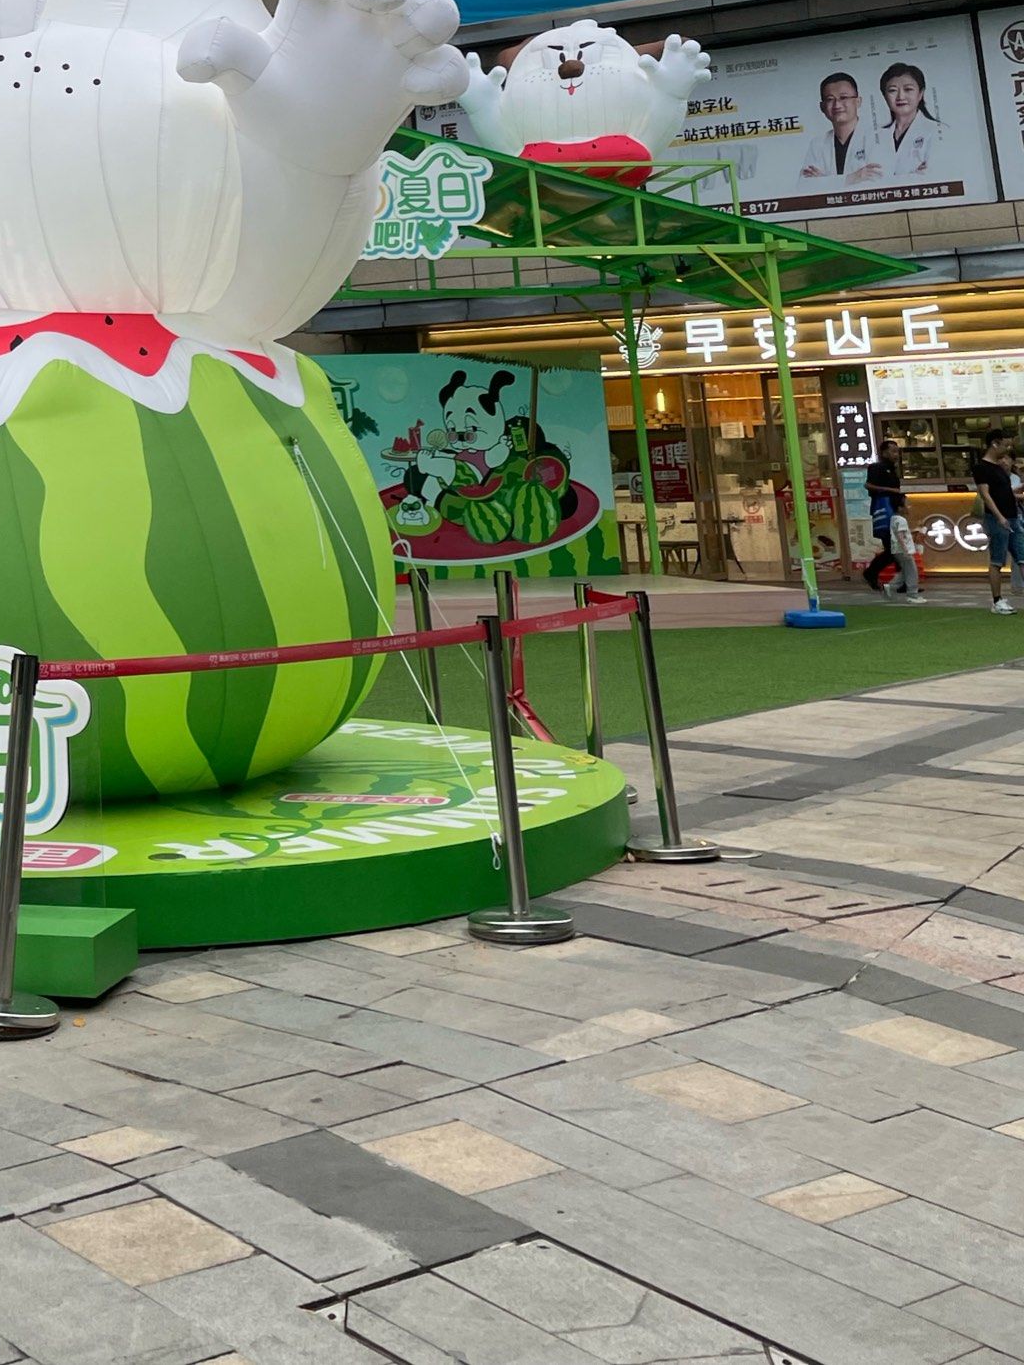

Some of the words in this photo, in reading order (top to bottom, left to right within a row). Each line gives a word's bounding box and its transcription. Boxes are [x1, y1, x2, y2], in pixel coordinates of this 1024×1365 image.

[379, 153, 483, 215] 夏日
[749, 202, 779, 213] 8177
[685, 305, 950, 363] 早安山丘
